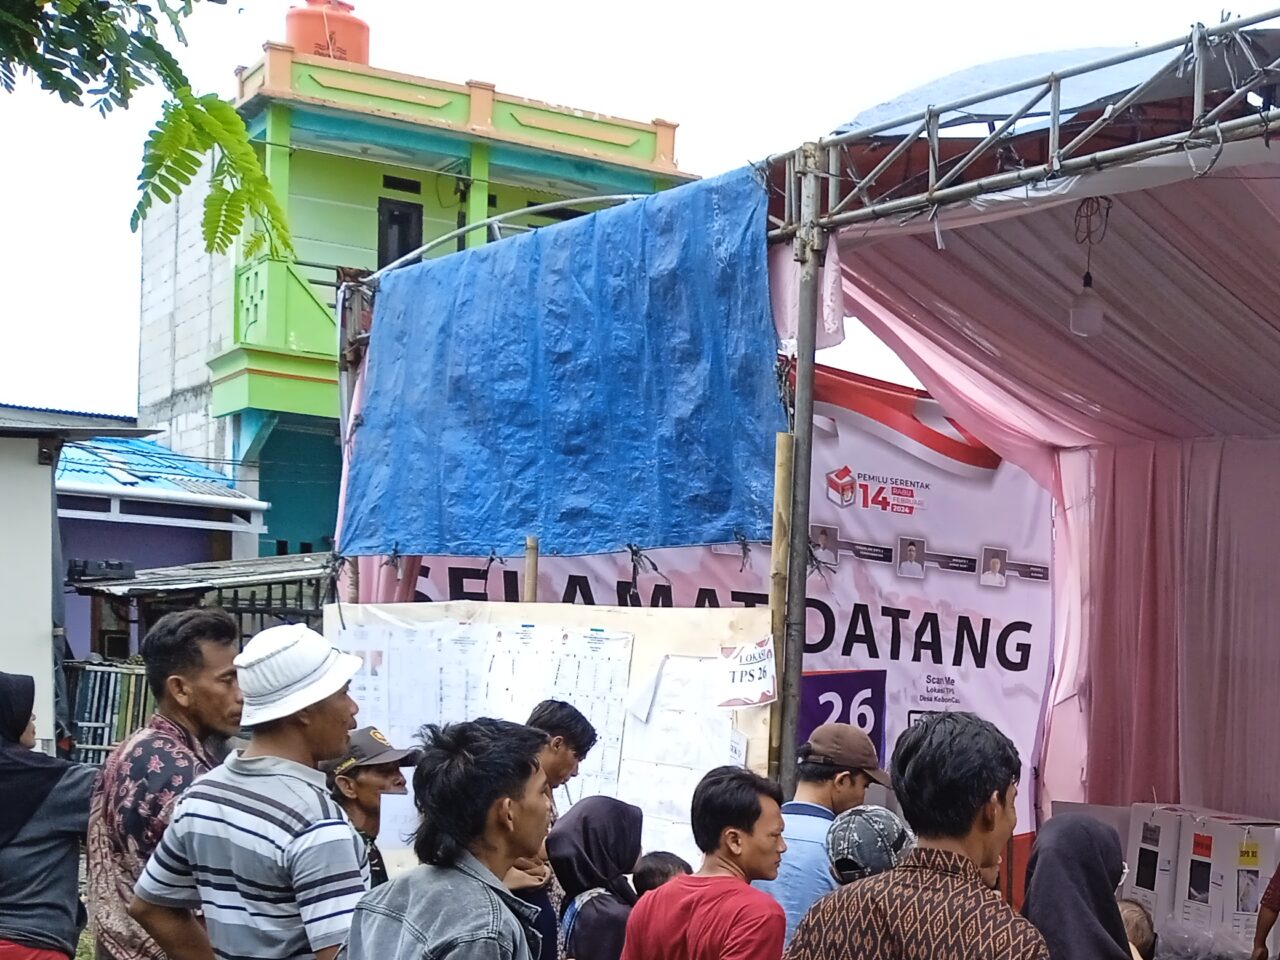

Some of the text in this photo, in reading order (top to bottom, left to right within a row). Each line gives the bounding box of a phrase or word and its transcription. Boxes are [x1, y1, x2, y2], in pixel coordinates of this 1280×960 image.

[857, 472, 930, 490] PEMILU SERENTAK
[858, 483, 890, 511] 14
[892, 505, 910, 513] 2024
[802, 597, 1033, 672] DATANG
[729, 665, 768, 683] TPS 26
[926, 674, 945, 685] Scan
[818, 688, 875, 735] 26
